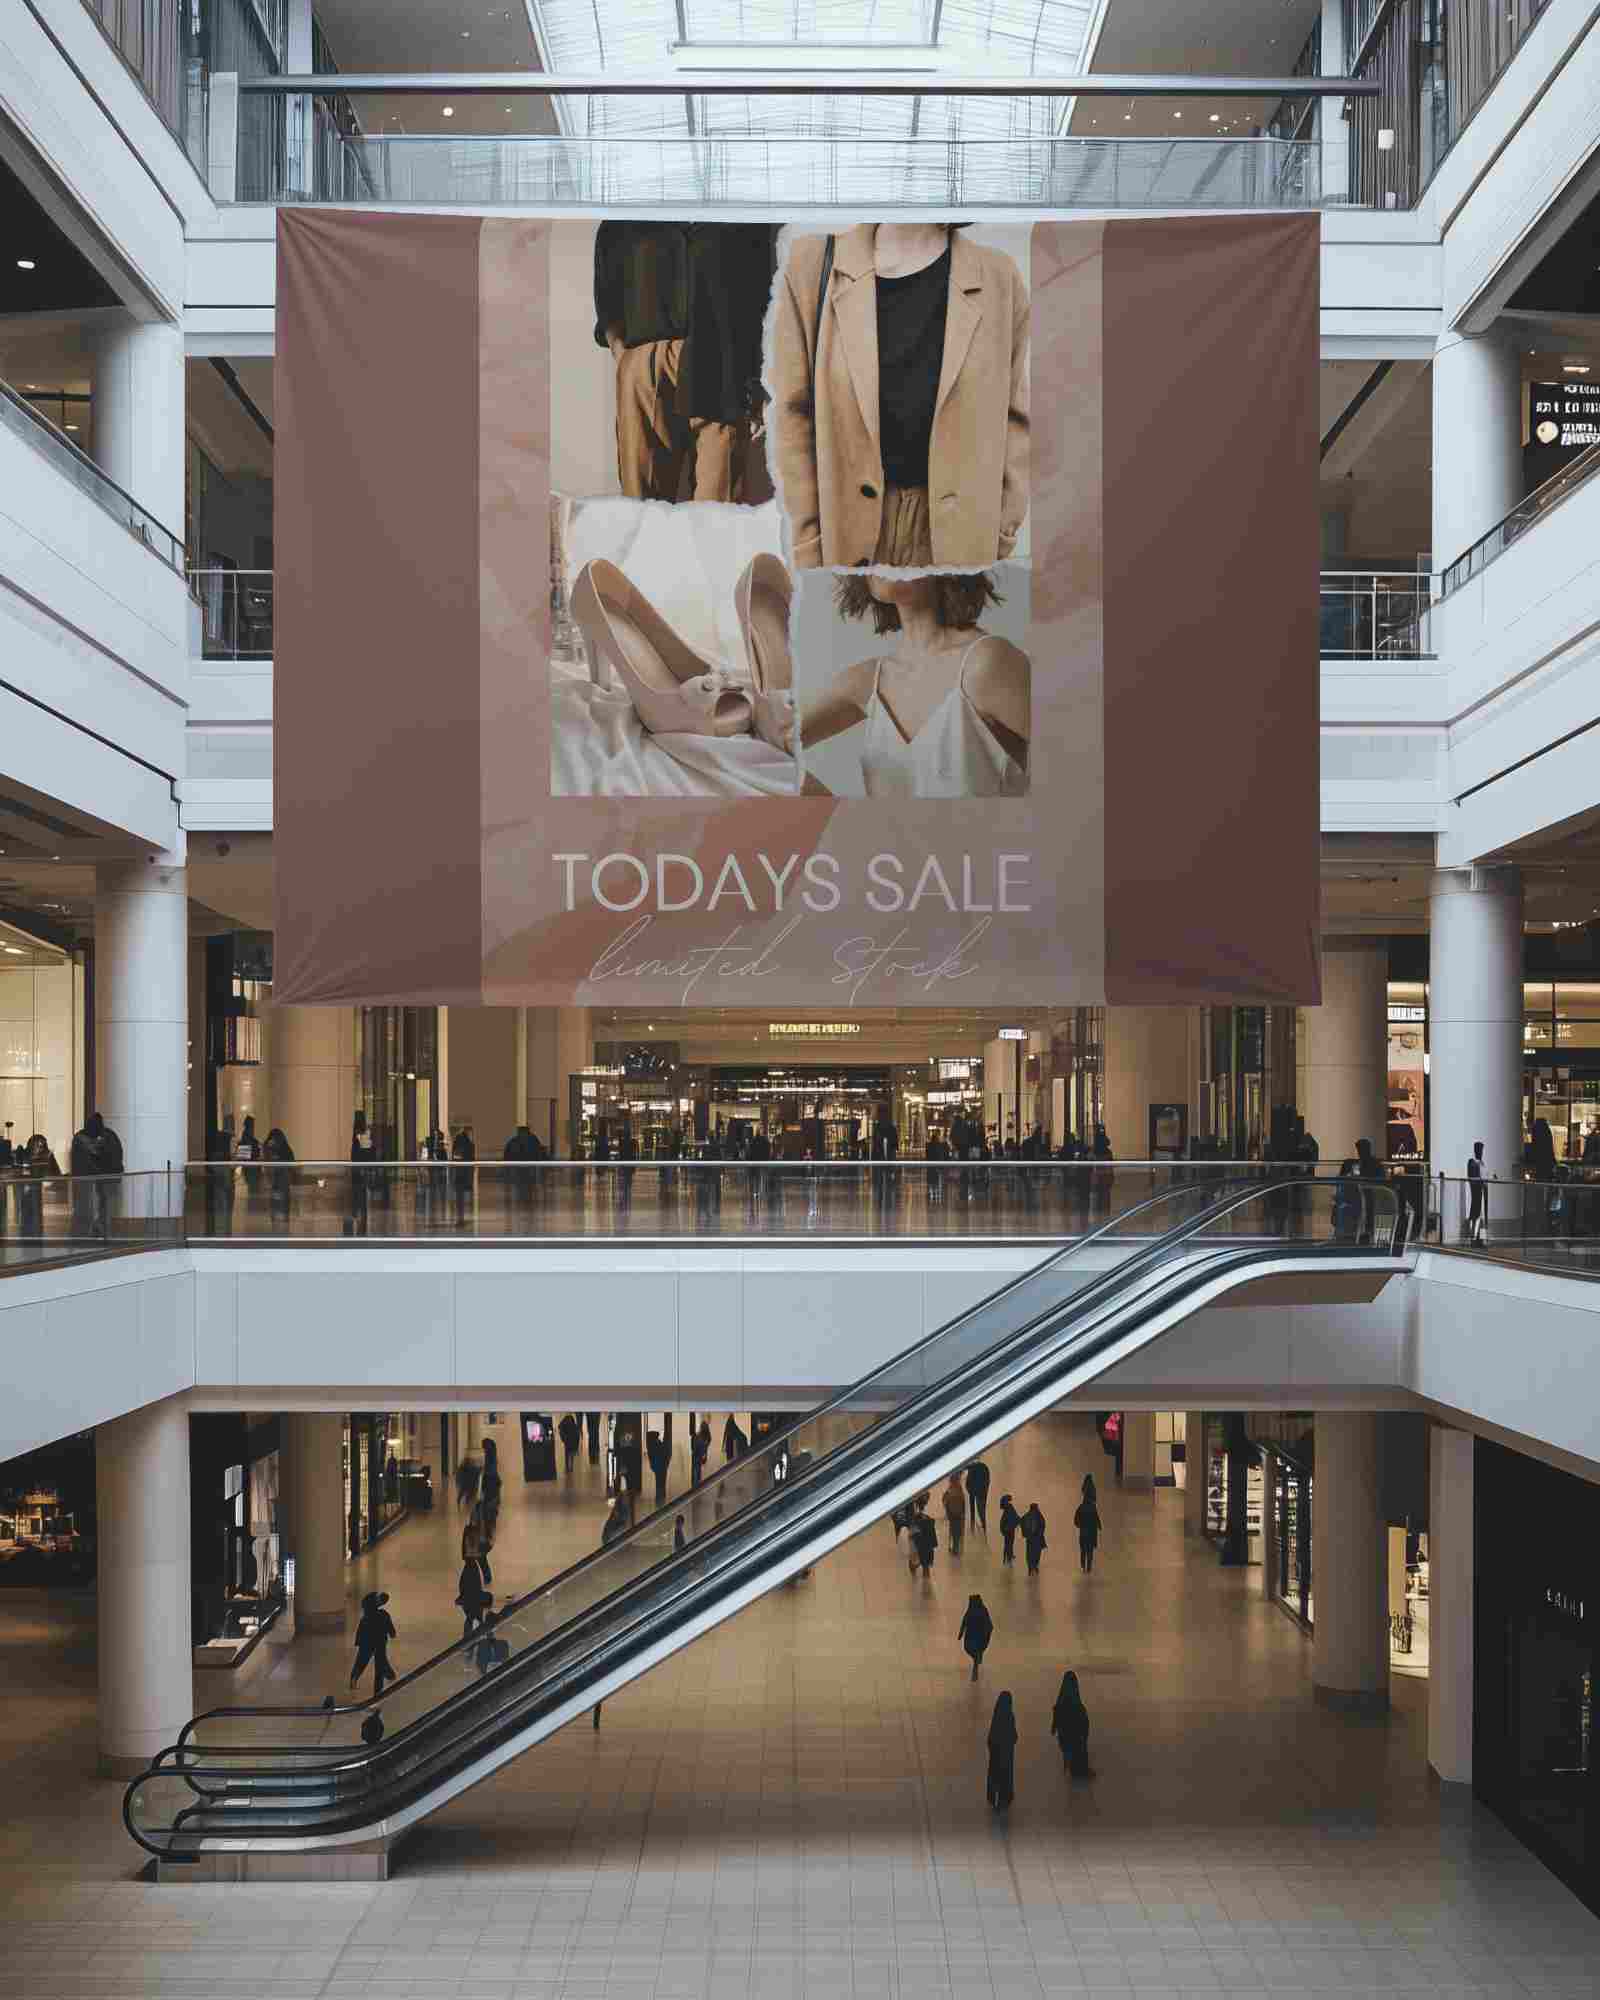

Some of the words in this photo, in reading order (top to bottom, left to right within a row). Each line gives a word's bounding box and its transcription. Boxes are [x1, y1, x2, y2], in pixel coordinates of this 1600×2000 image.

[551, 853, 841, 912] TODAYS
[865, 853, 1032, 912] SALE
[589, 914, 802, 1006] limited
